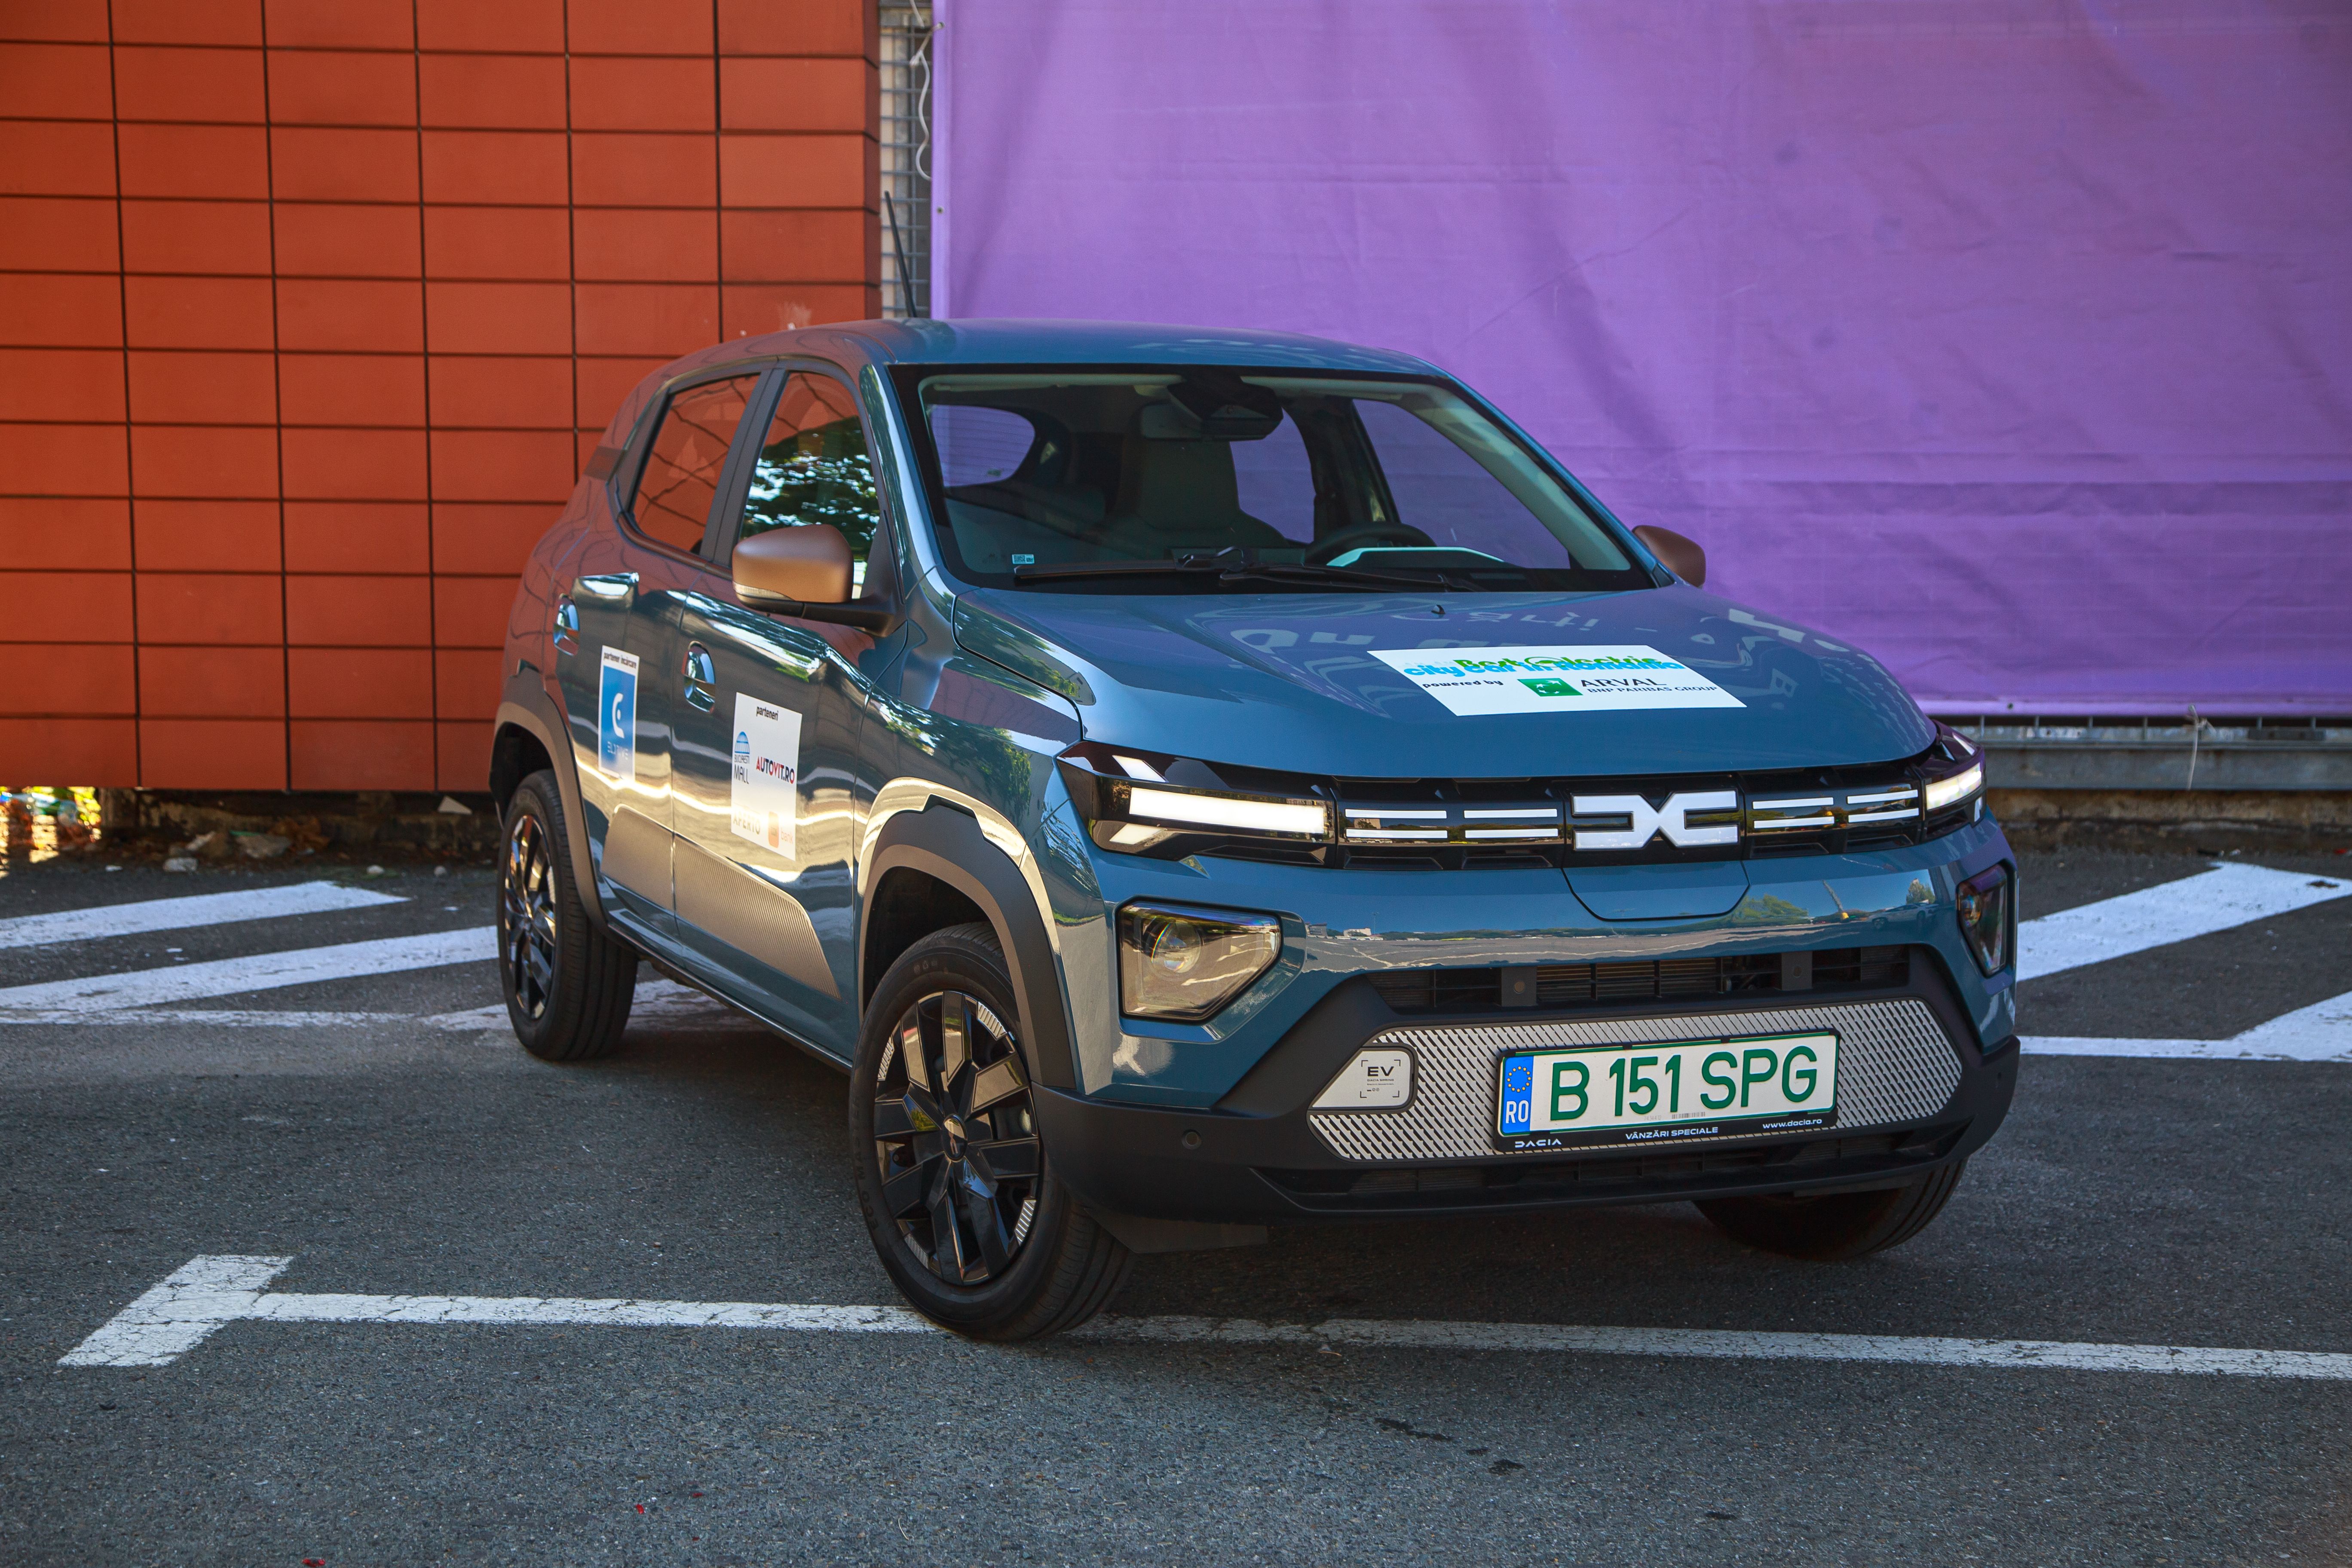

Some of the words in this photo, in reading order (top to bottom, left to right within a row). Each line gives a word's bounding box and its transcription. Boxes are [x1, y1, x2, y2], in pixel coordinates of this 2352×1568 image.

[1404, 665, 1466, 677] city
[1464, 665, 1517, 673] car
[1516, 662, 1554, 671] in
[1581, 678, 1667, 687] ARVAL
[756, 706, 779, 721] parteneri
[734, 764, 749, 784] MALL
[756, 756, 795, 784] AUTOVIT.RO
[1368, 1066, 1394, 1076] EV
[1550, 1061, 1590, 1121] B
[1609, 1054, 1682, 1117] 151
[1700, 1046, 1818, 1109] SPG
[1505, 1099, 1529, 1124] RO
[1763, 1118, 1822, 1129] www.dacia.ro
[1626, 1130, 1669, 1140] VÂNZĂRI
[1671, 1127, 1718, 1136] SPECIALE
[1515, 1138, 1562, 1148] DACIA
